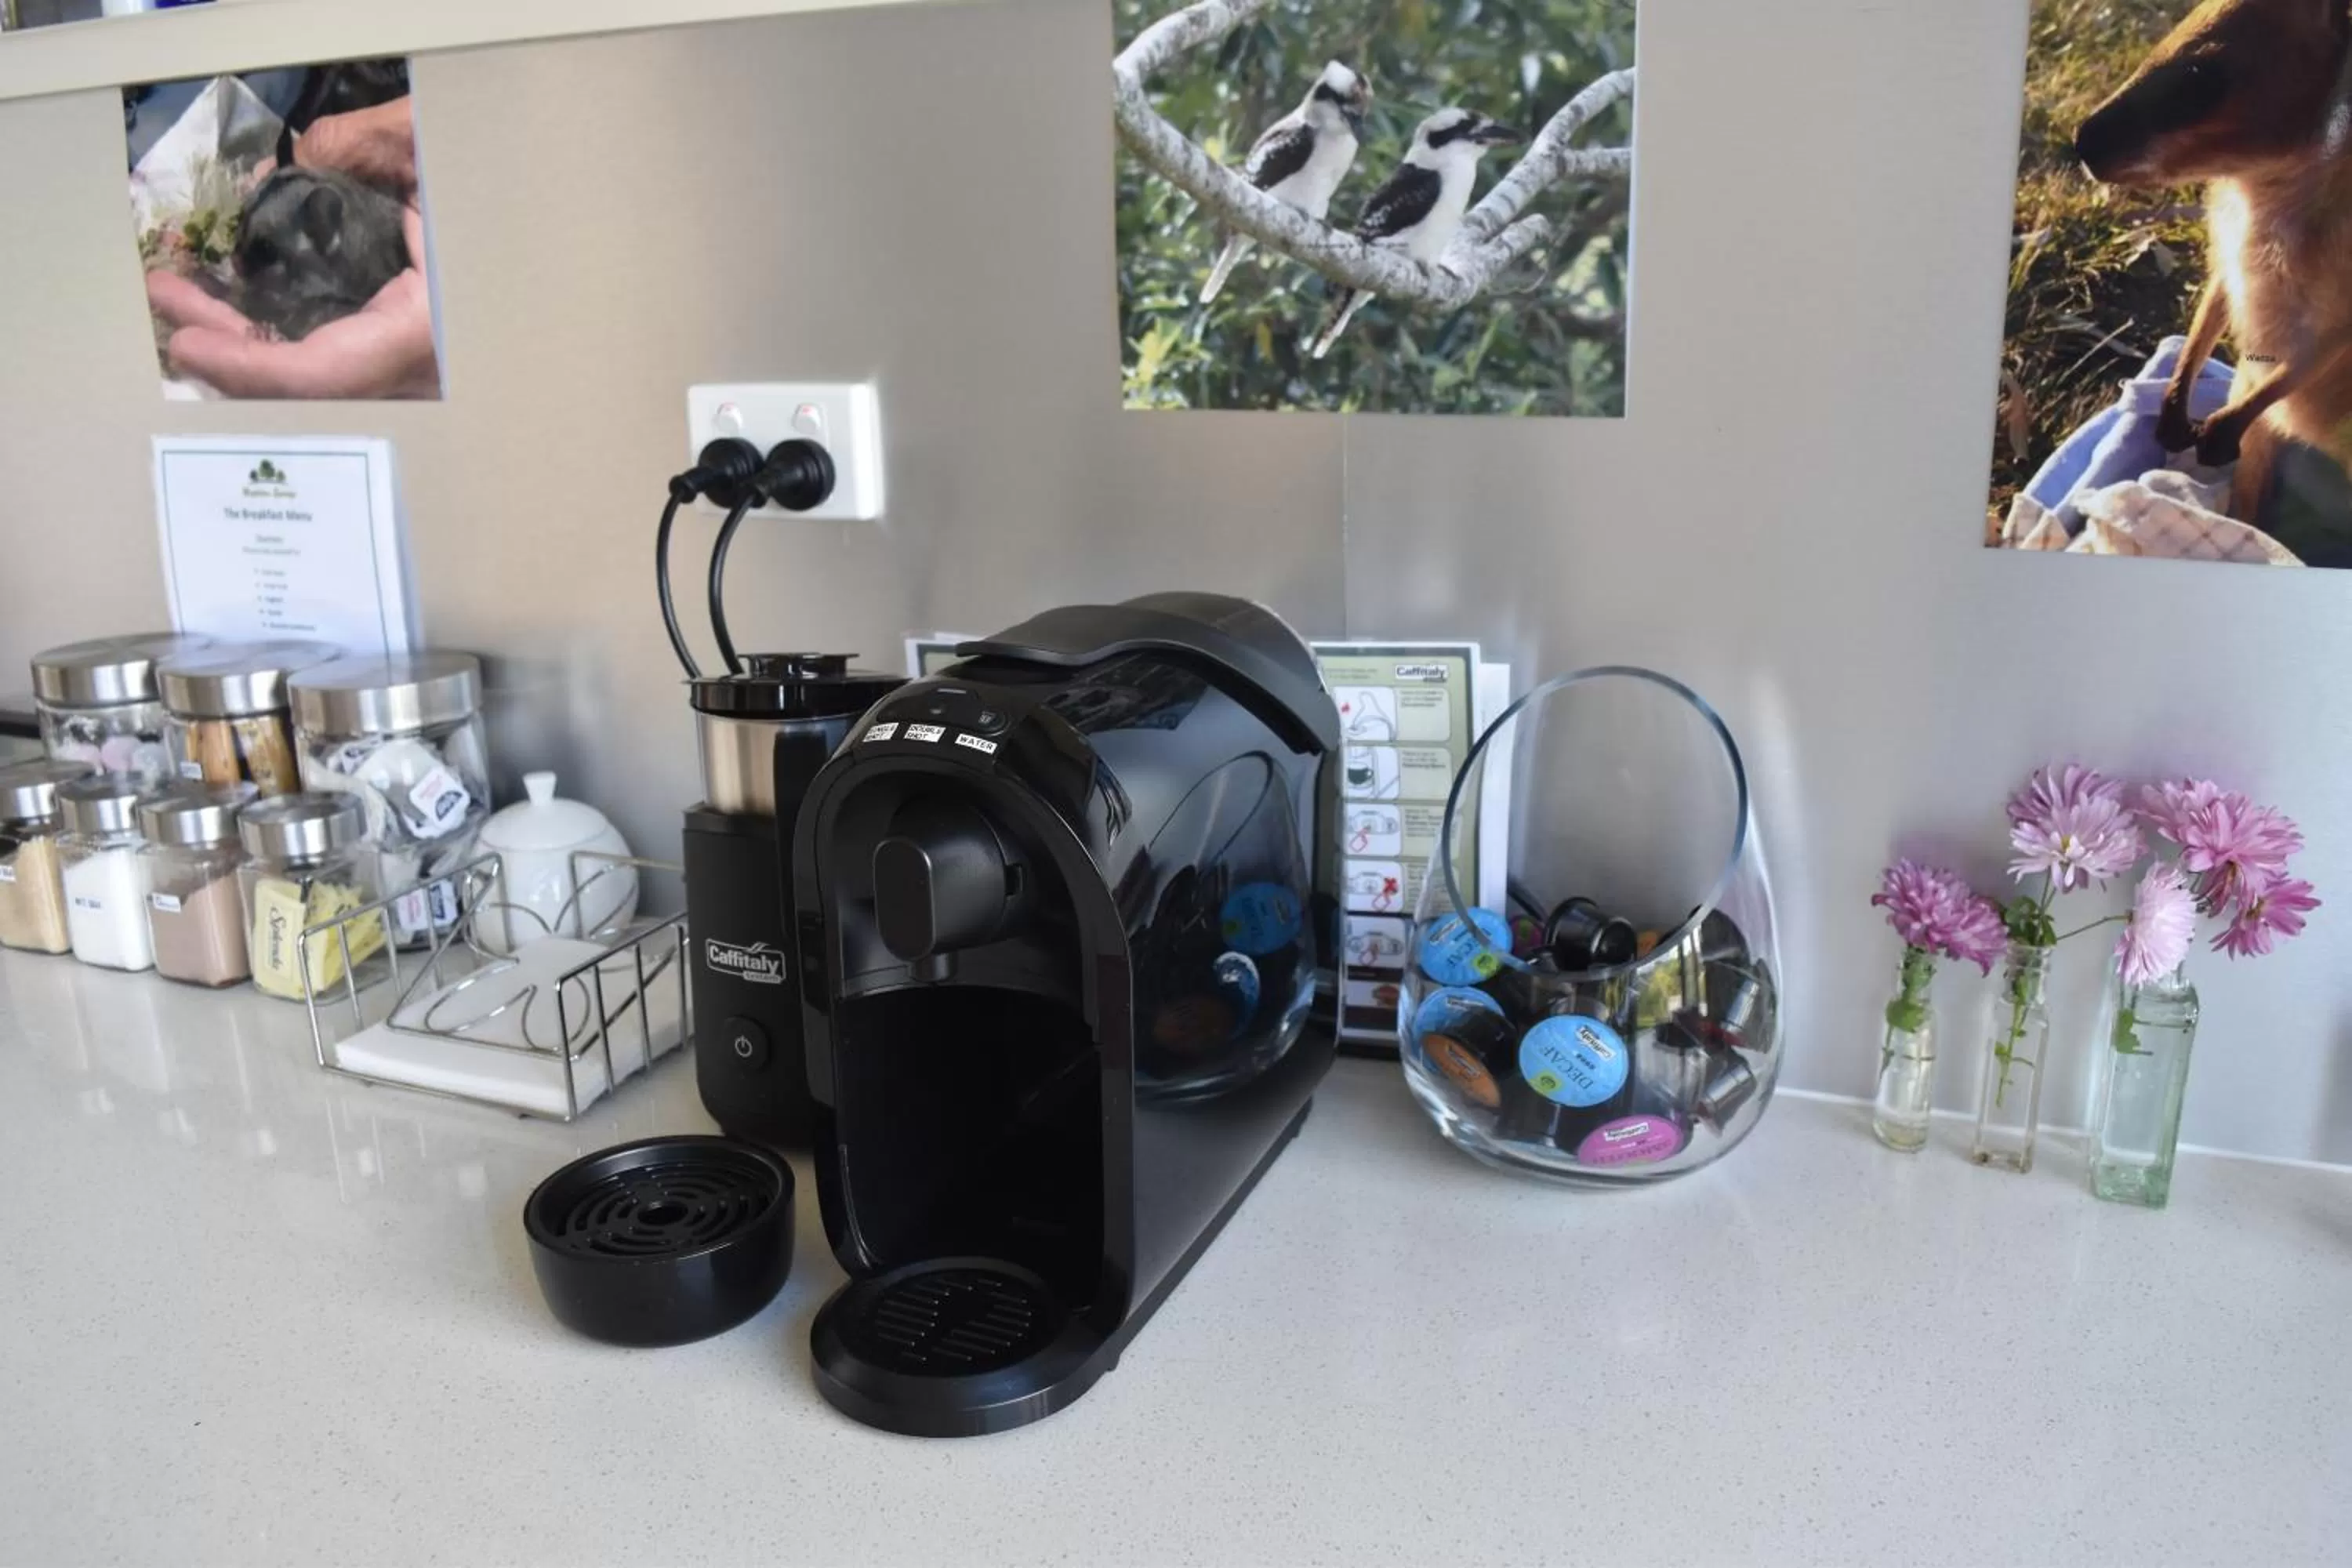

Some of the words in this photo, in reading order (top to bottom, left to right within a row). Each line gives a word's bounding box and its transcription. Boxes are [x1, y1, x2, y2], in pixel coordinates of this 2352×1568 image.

[906, 731, 929, 740] SHOT
[909, 724, 942, 735] DOUBLE
[959, 735, 995, 751] WATER
[709, 944, 780, 978] Caffitaly
[1539, 1046, 1594, 1090] DECAF
